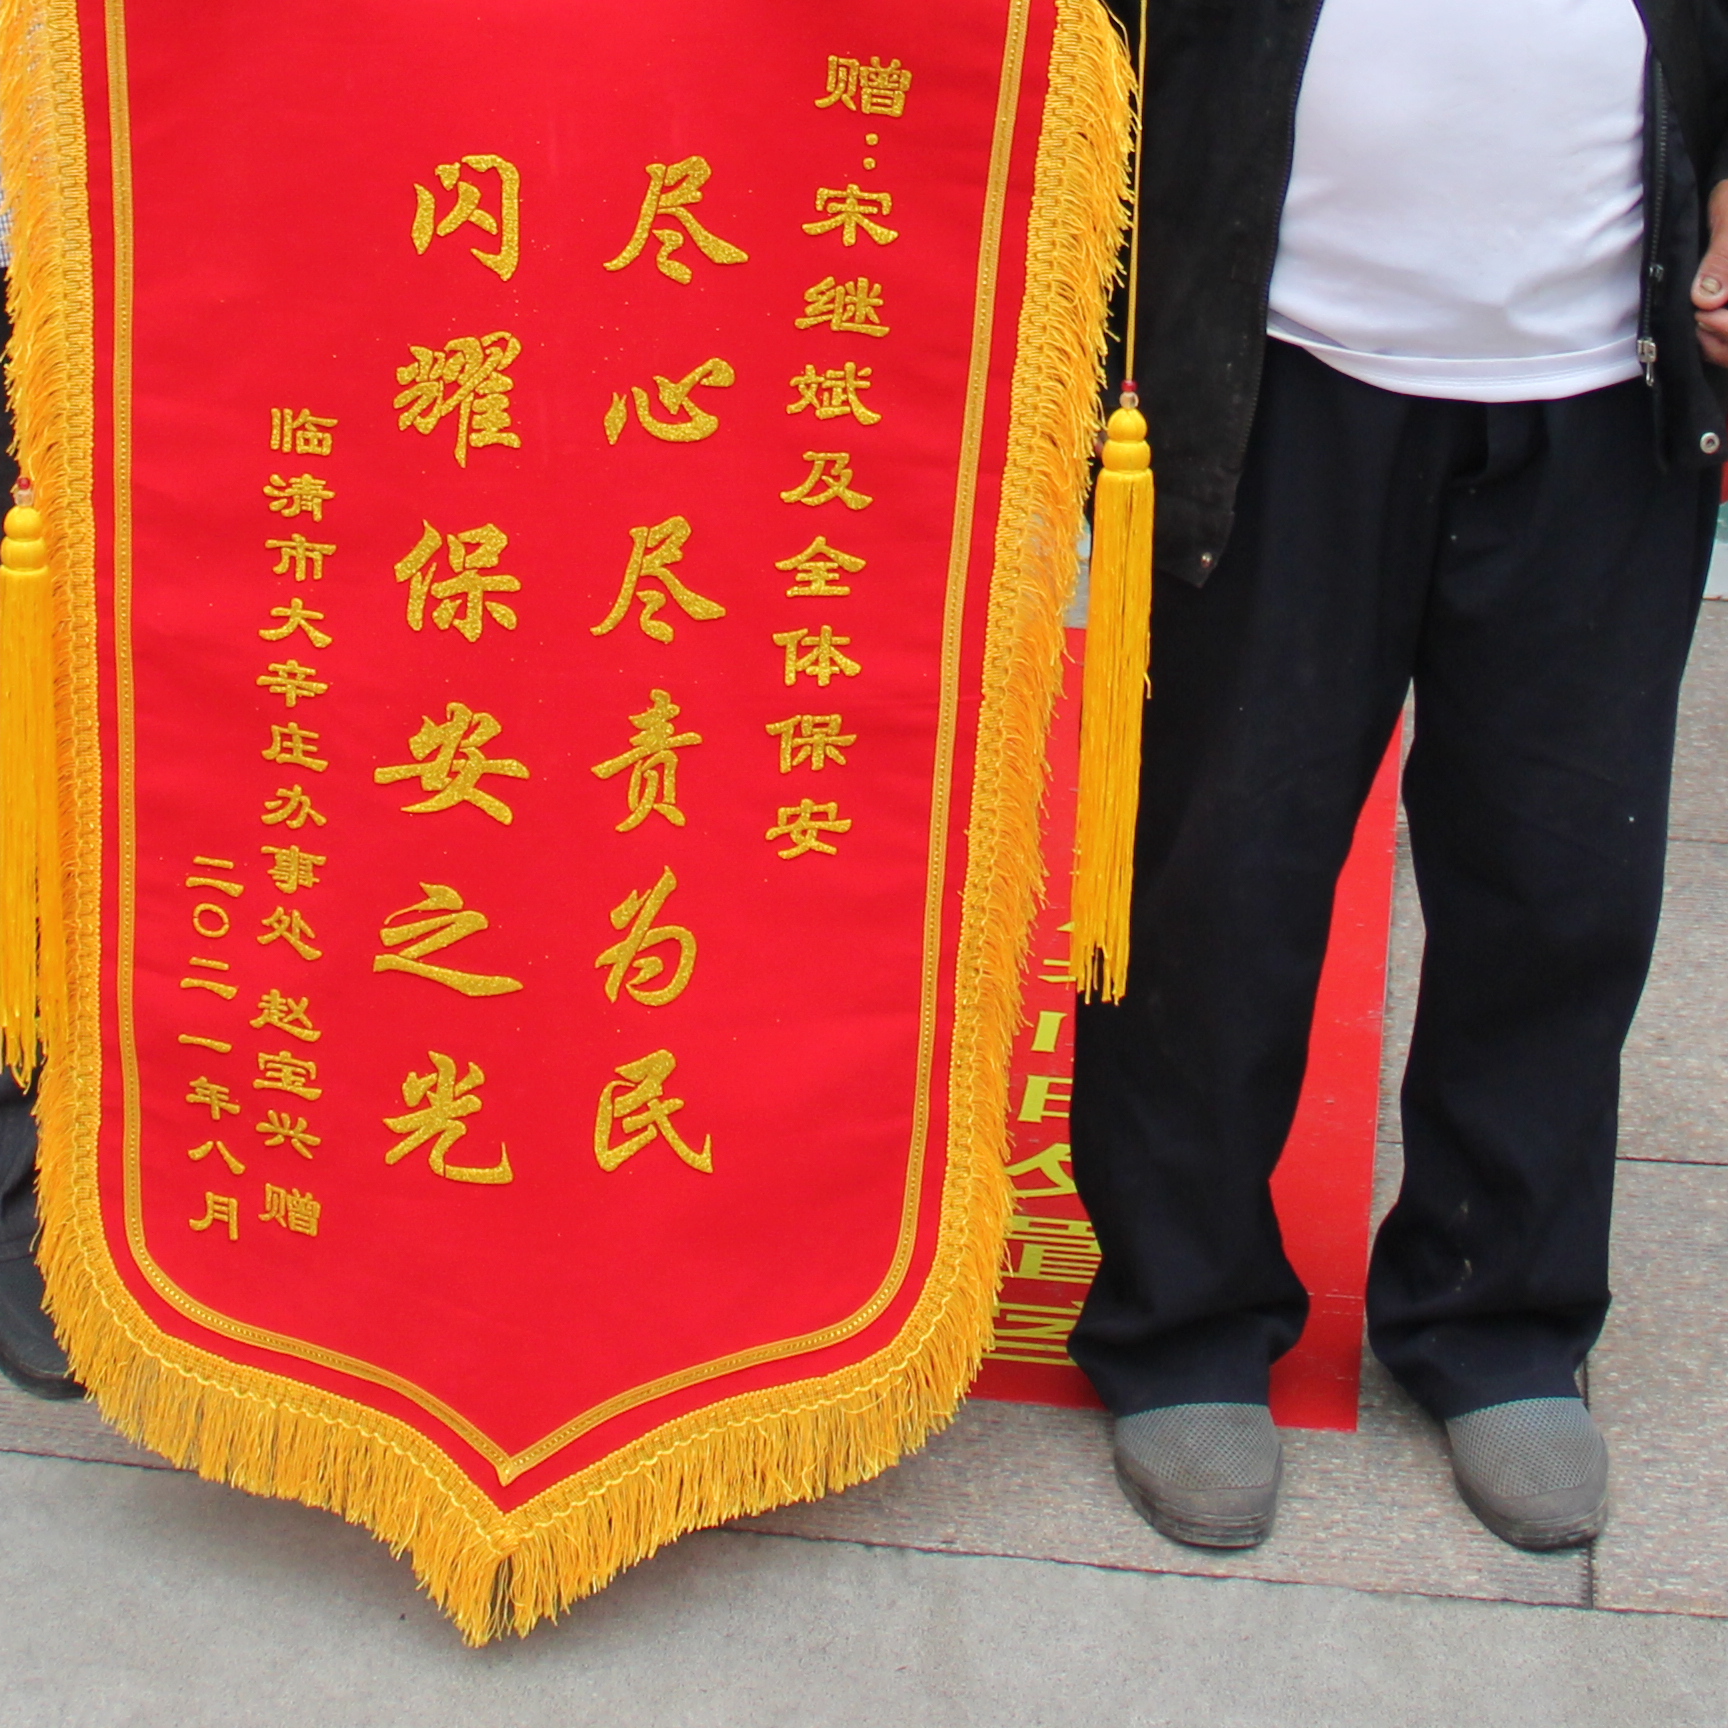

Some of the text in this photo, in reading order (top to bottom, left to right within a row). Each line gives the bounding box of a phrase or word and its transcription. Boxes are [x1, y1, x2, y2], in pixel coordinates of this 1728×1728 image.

[373, 152, 529, 1184] 闪耀保安之光
[589, 154, 749, 1174] 尽心尽责为民
